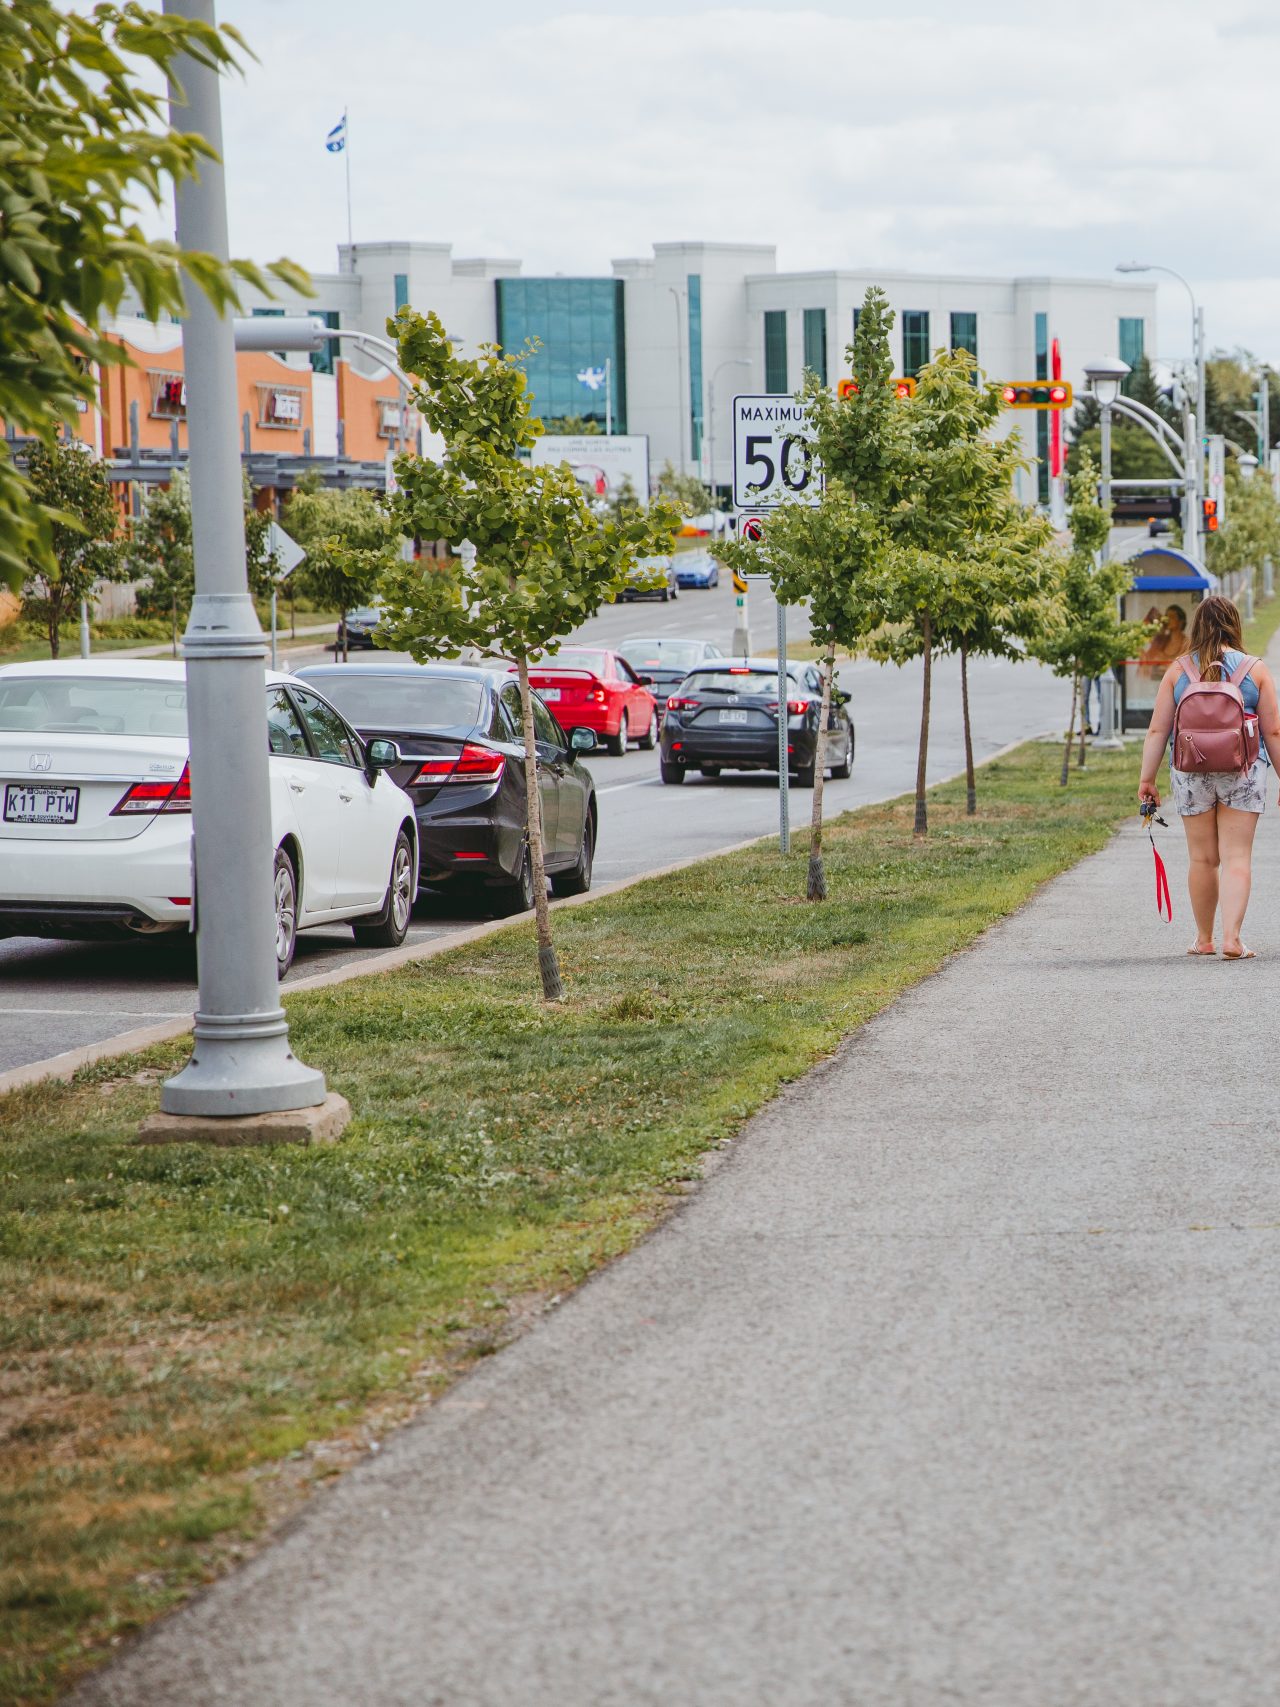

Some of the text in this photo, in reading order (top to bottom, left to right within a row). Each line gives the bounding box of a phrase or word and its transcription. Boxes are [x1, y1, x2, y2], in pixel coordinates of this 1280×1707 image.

[745, 434, 812, 492] 50
[8, 794, 75, 813] K11 PTW
